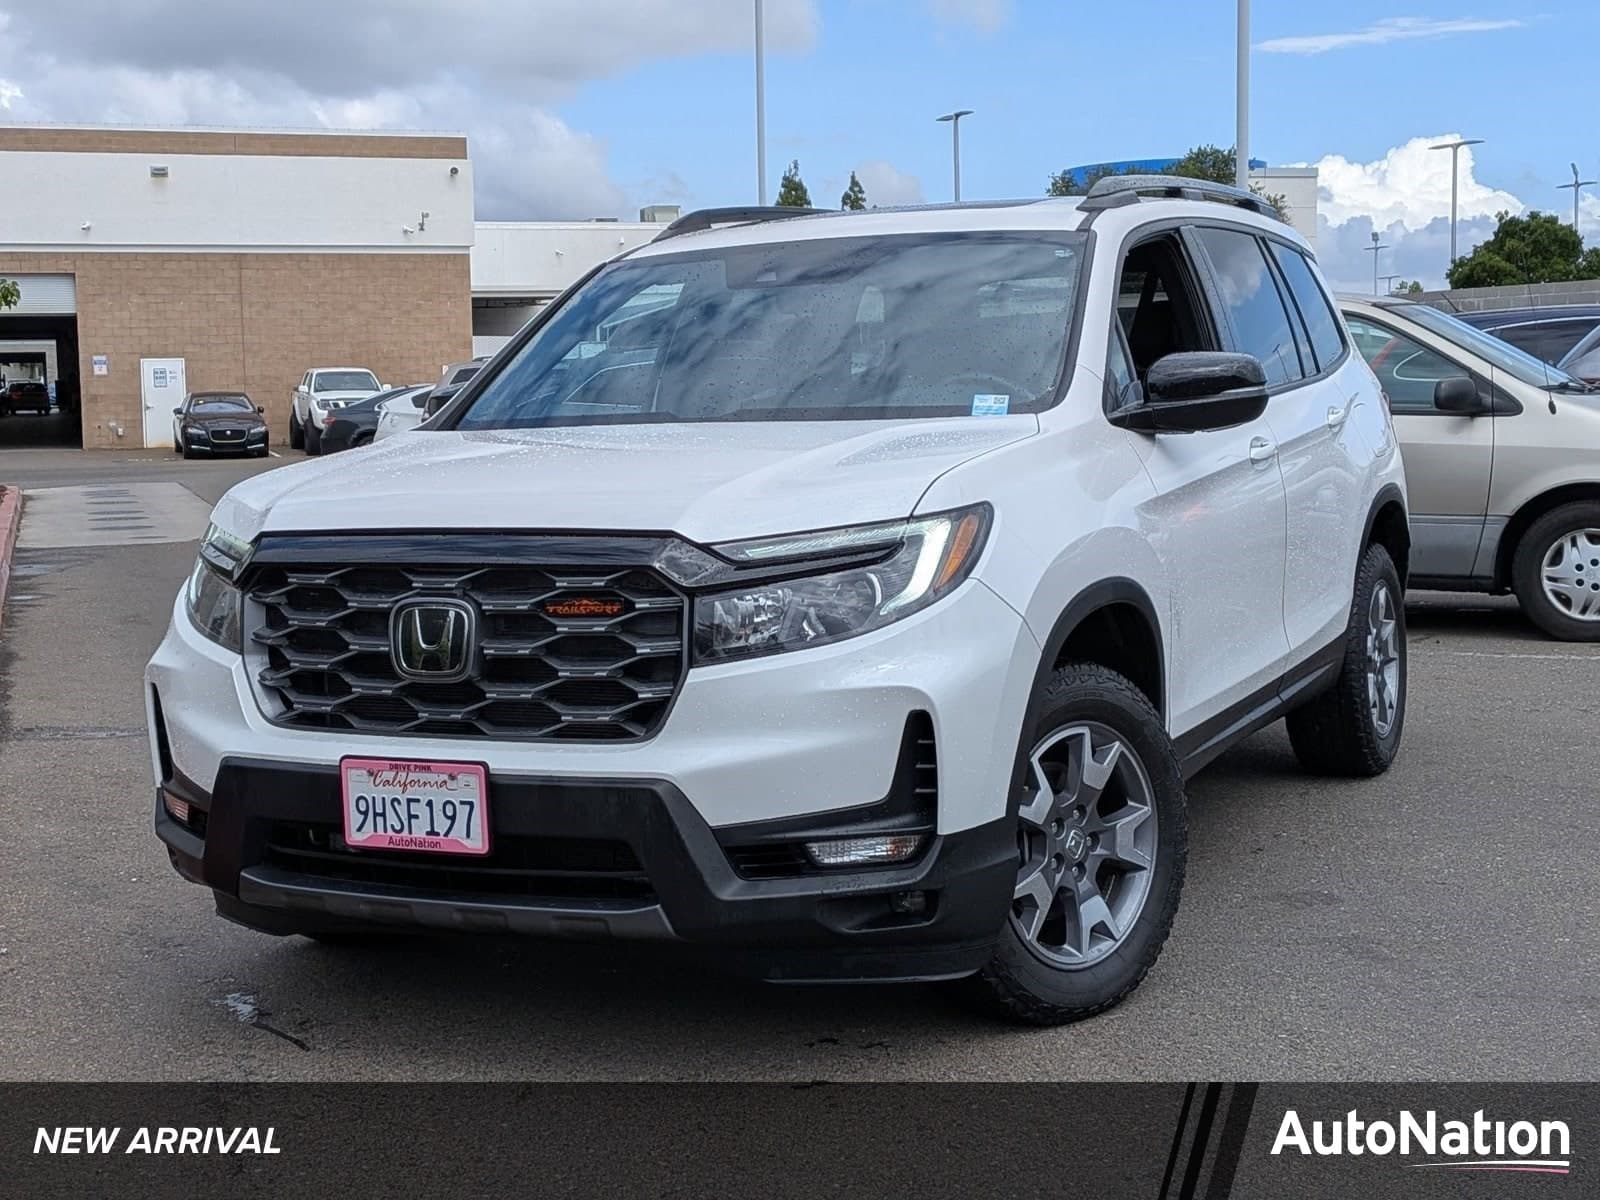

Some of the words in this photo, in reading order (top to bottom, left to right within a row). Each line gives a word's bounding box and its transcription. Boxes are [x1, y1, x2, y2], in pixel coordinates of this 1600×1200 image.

[389, 763, 412, 771] DRIVE
[414, 764, 432, 772] PINK
[372, 770, 458, 794] California
[355, 794, 475, 839] 9HSF197
[388, 836, 441, 849] AutoNation
